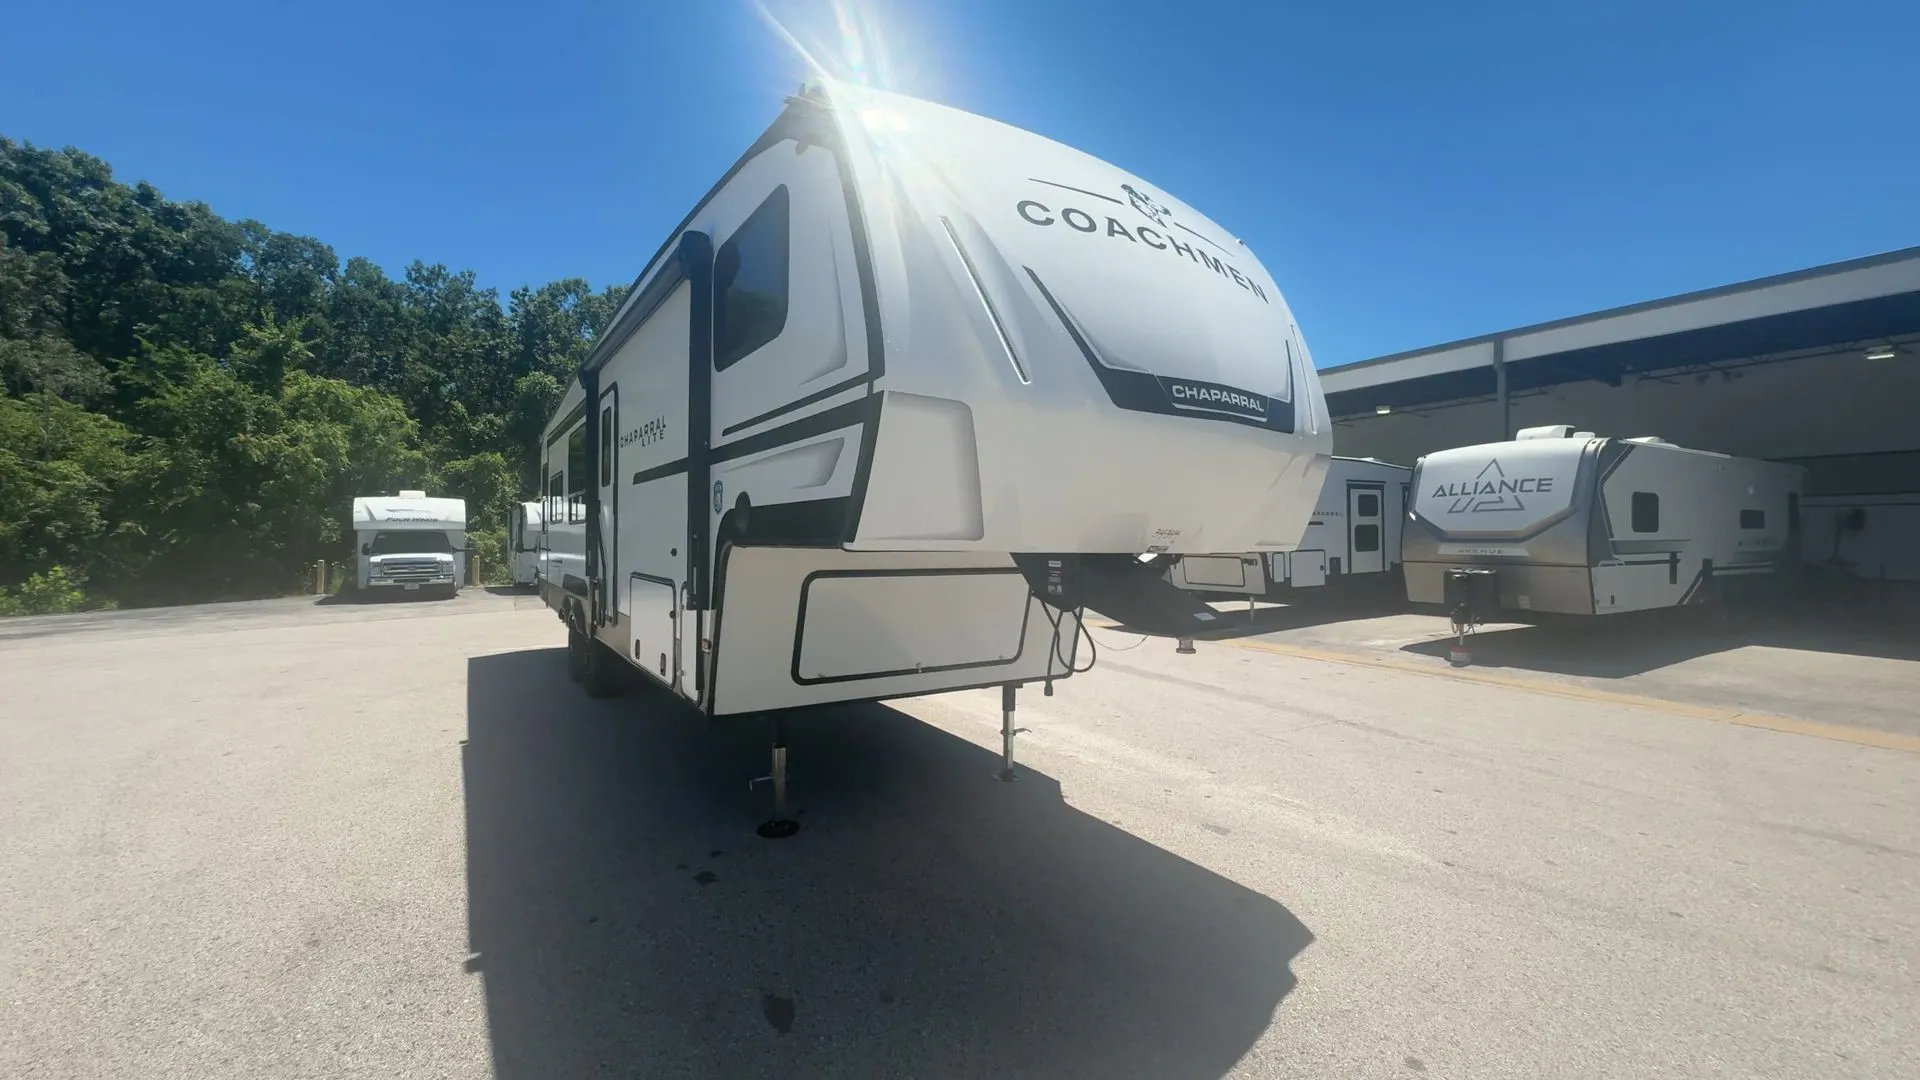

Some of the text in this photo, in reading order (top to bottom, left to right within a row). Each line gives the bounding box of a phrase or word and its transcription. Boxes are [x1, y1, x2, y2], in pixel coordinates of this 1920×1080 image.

[1017, 200, 1269, 304] COACHMEN
[1172, 385, 1265, 412] CHAPARRAL
[620, 415, 667, 448] CHAPARRAL
[641, 429, 665, 447] LITE
[1432, 478, 1554, 498] ALLIANCE
[1459, 547, 1504, 555] AVENUE
